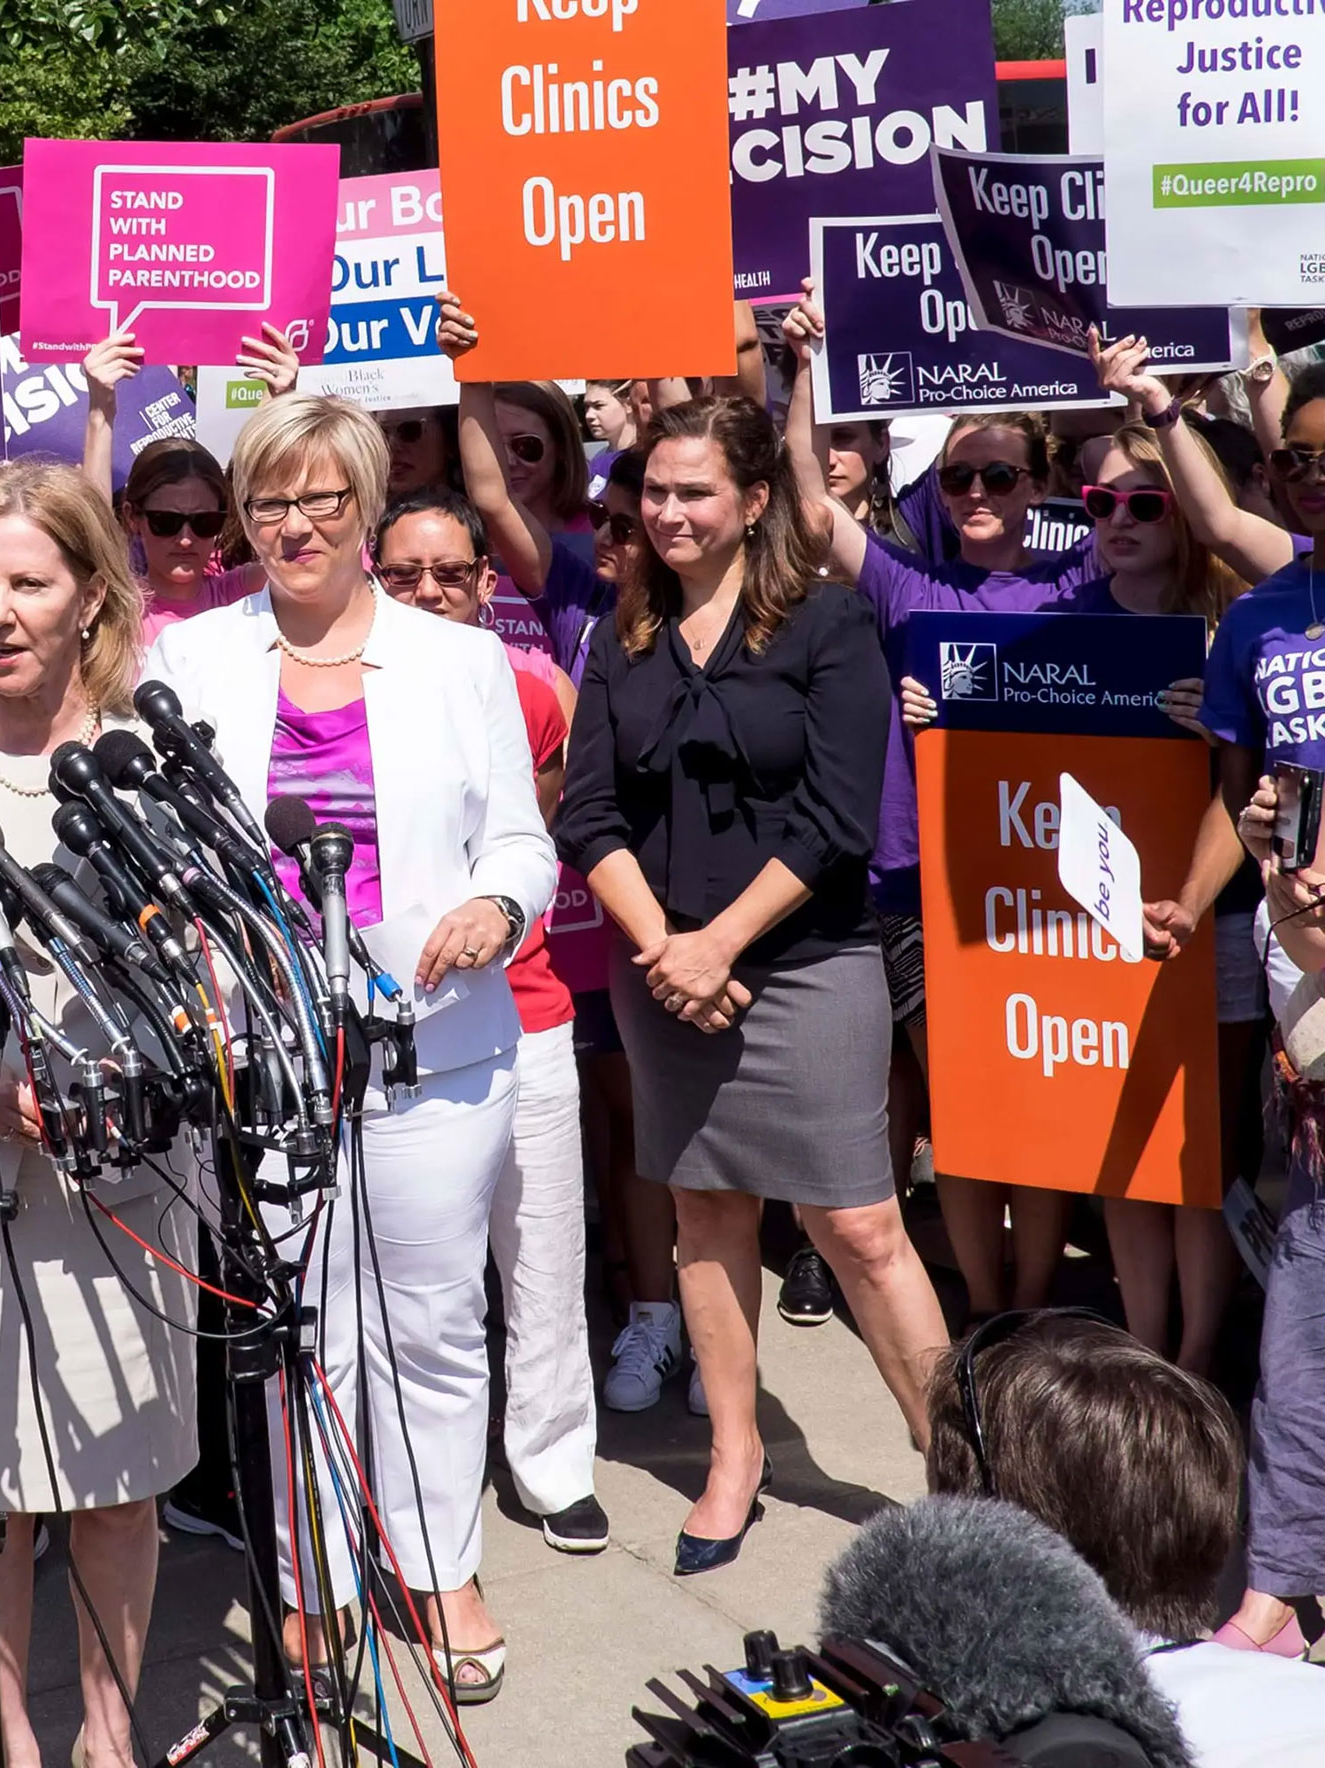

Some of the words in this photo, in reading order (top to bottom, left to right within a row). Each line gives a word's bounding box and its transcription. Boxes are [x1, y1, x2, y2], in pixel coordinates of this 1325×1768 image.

[1176, 36, 1302, 74] Justice
[728, 48, 890, 121] #MY
[501, 59, 659, 136] Clinics
[1177, 91, 1230, 127] for
[1236, 88, 1299, 125] All!
[1161, 171, 1317, 198] #Queer4Repro
[110, 191, 183, 209] STAND
[968, 166, 1049, 230] Keep
[110, 218, 166, 235] WITH
[522, 176, 645, 261] Open
[109, 244, 215, 262] PLANNED
[855, 232, 942, 285] Keep
[108, 270, 261, 288] PARENTHOOD
[734, 270, 771, 290] HEALTH
[348, 368, 384, 382] Black
[916, 362, 1006, 385] NARAL
[918, 384, 1007, 403] Pro-Choice
[1011, 381, 1078, 398] America
[145, 392, 181, 418] CENTER
[152, 411, 172, 429] FOR
[495, 618, 548, 636] STAN
[1002, 662, 1096, 686] NARAL
[1004, 688, 1096, 705] Pro-Choice
[1266, 715, 1325, 749] ASK
[985, 886, 1143, 963] Clinic
[1005, 993, 1129, 1077] Open
